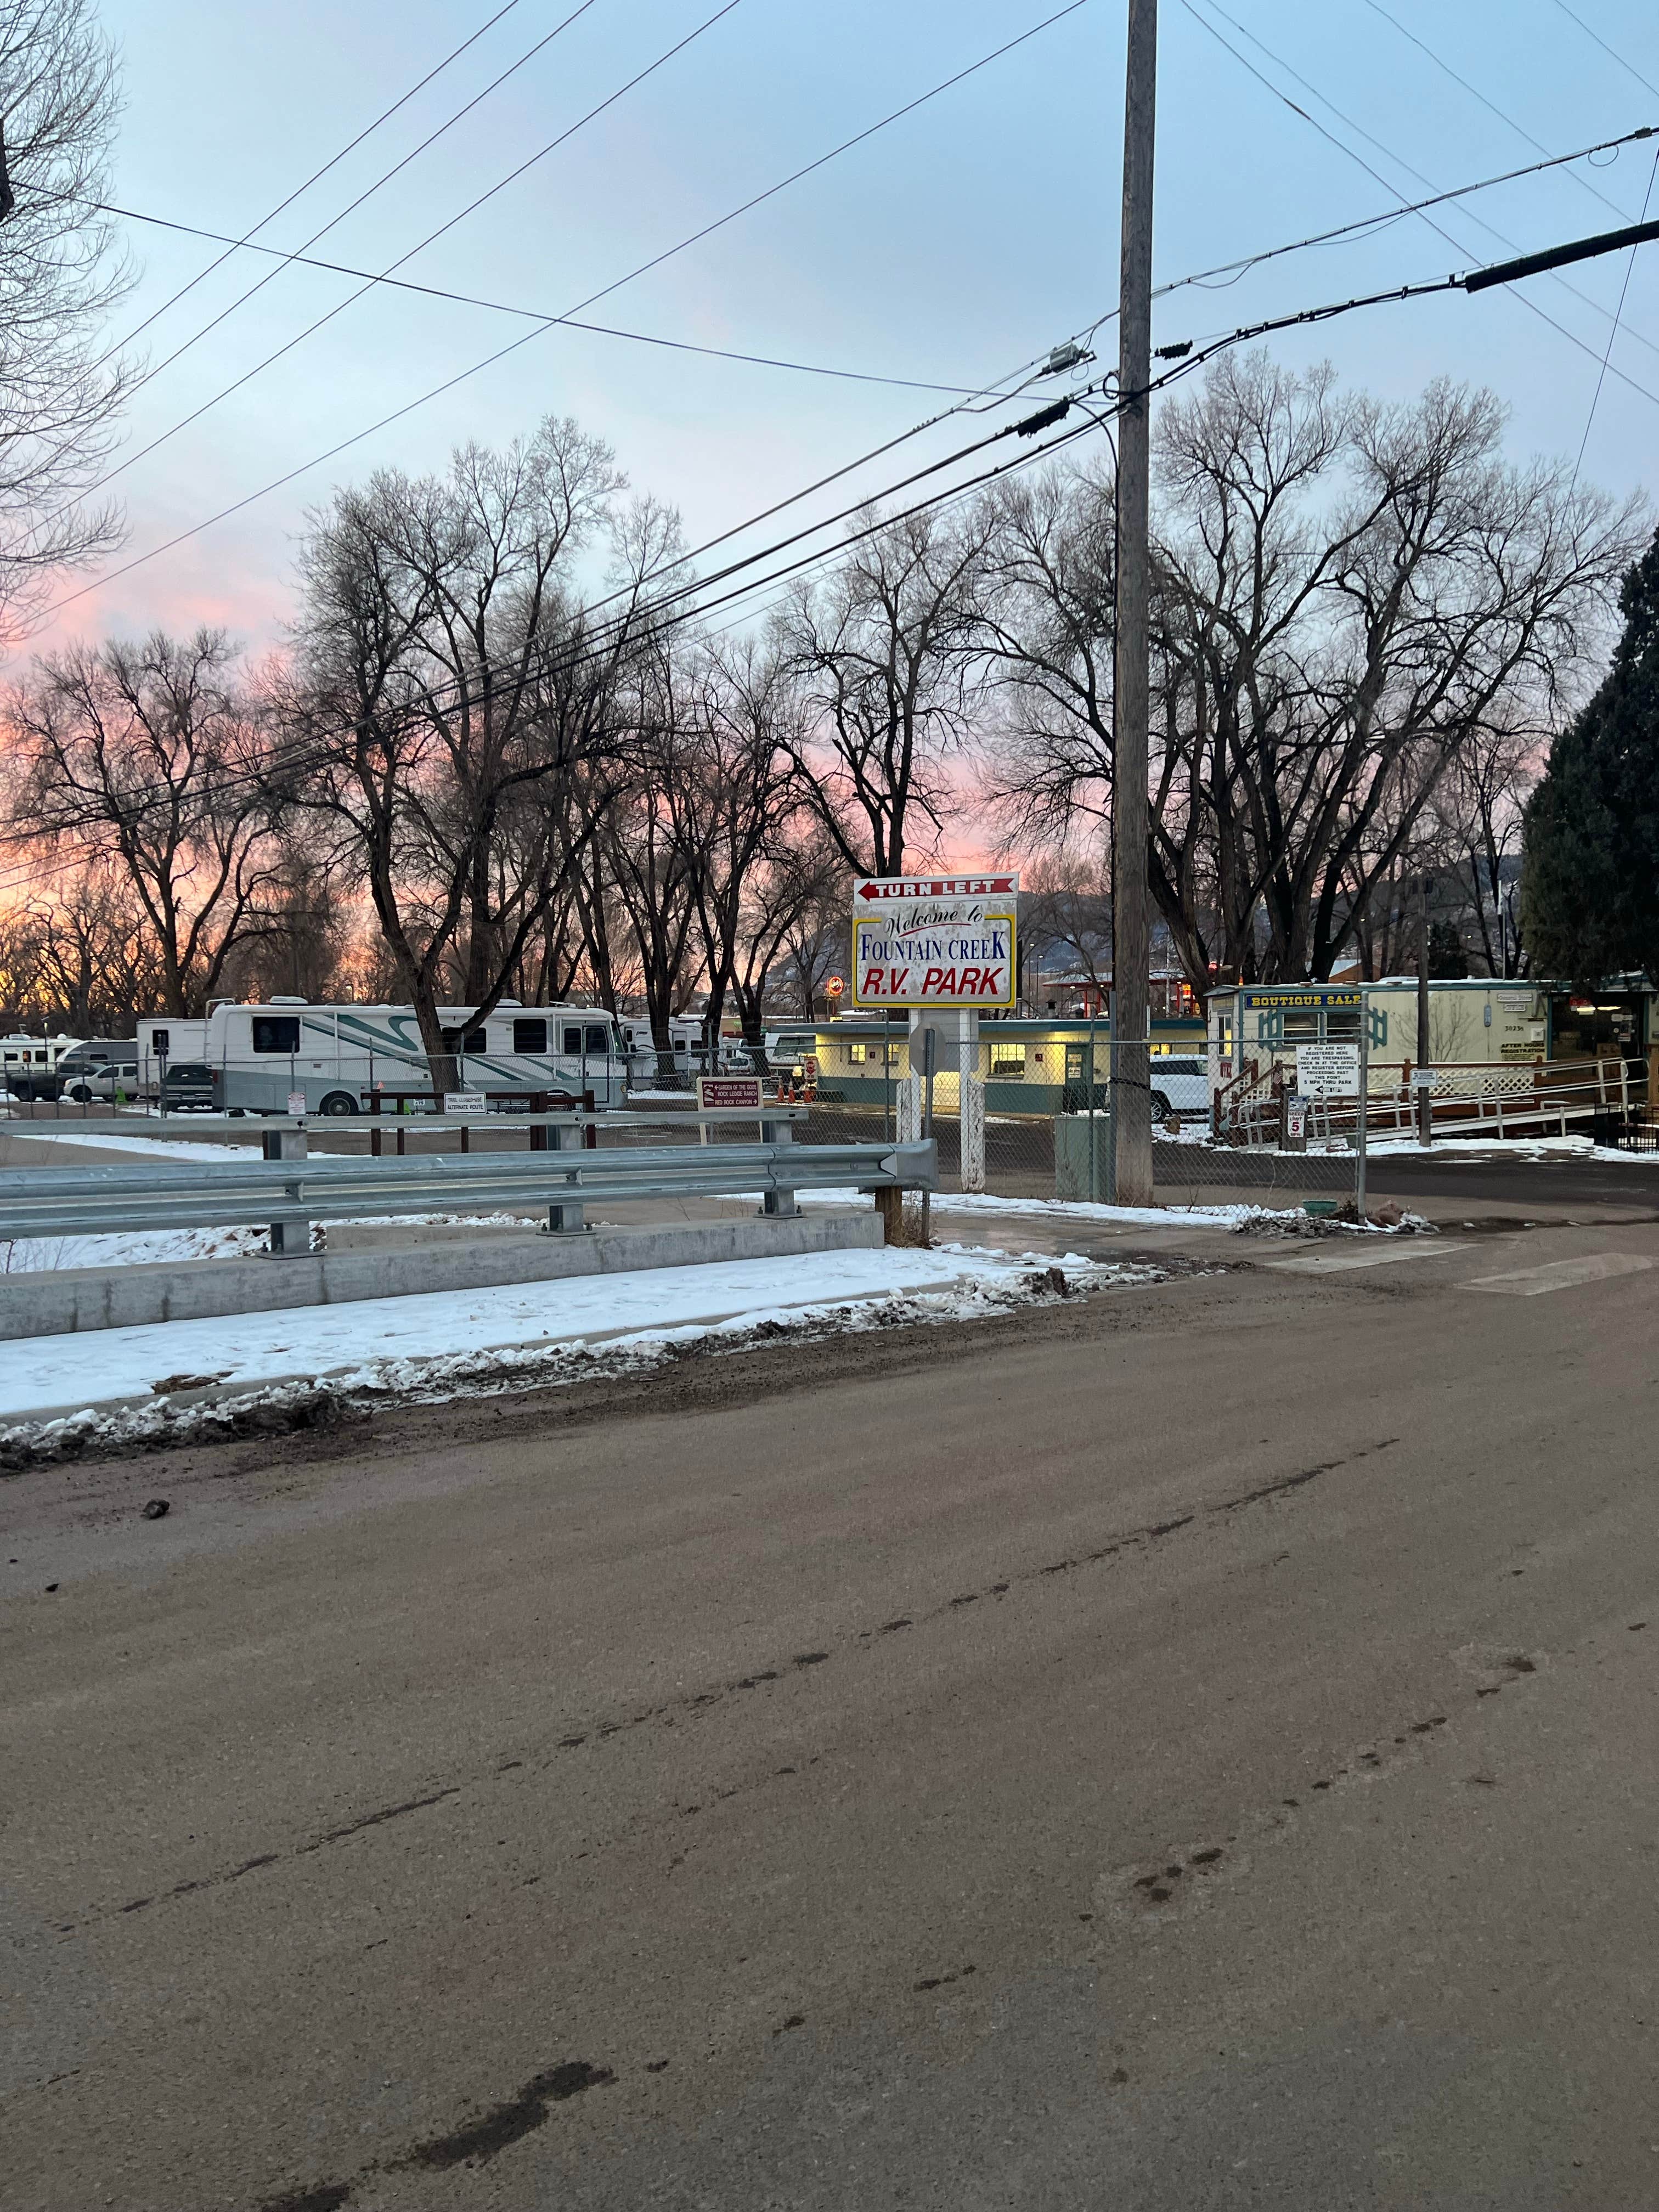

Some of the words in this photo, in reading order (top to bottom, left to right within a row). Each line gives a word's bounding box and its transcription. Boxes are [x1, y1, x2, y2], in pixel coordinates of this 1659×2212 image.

[876, 883, 932, 897] TURN
[943, 880, 995, 894] LEFT
[884, 907, 958, 938] Welcome
[967, 905, 984, 923] to
[861, 934, 942, 961] FOUNTAIN
[949, 931, 1006, 960] CREEK
[862, 968, 910, 995] R.V.
[921, 967, 1005, 995] PARK
[1251, 996, 1322, 1006] BOUTIQUE
[1291, 1121, 1300, 1132] 5
